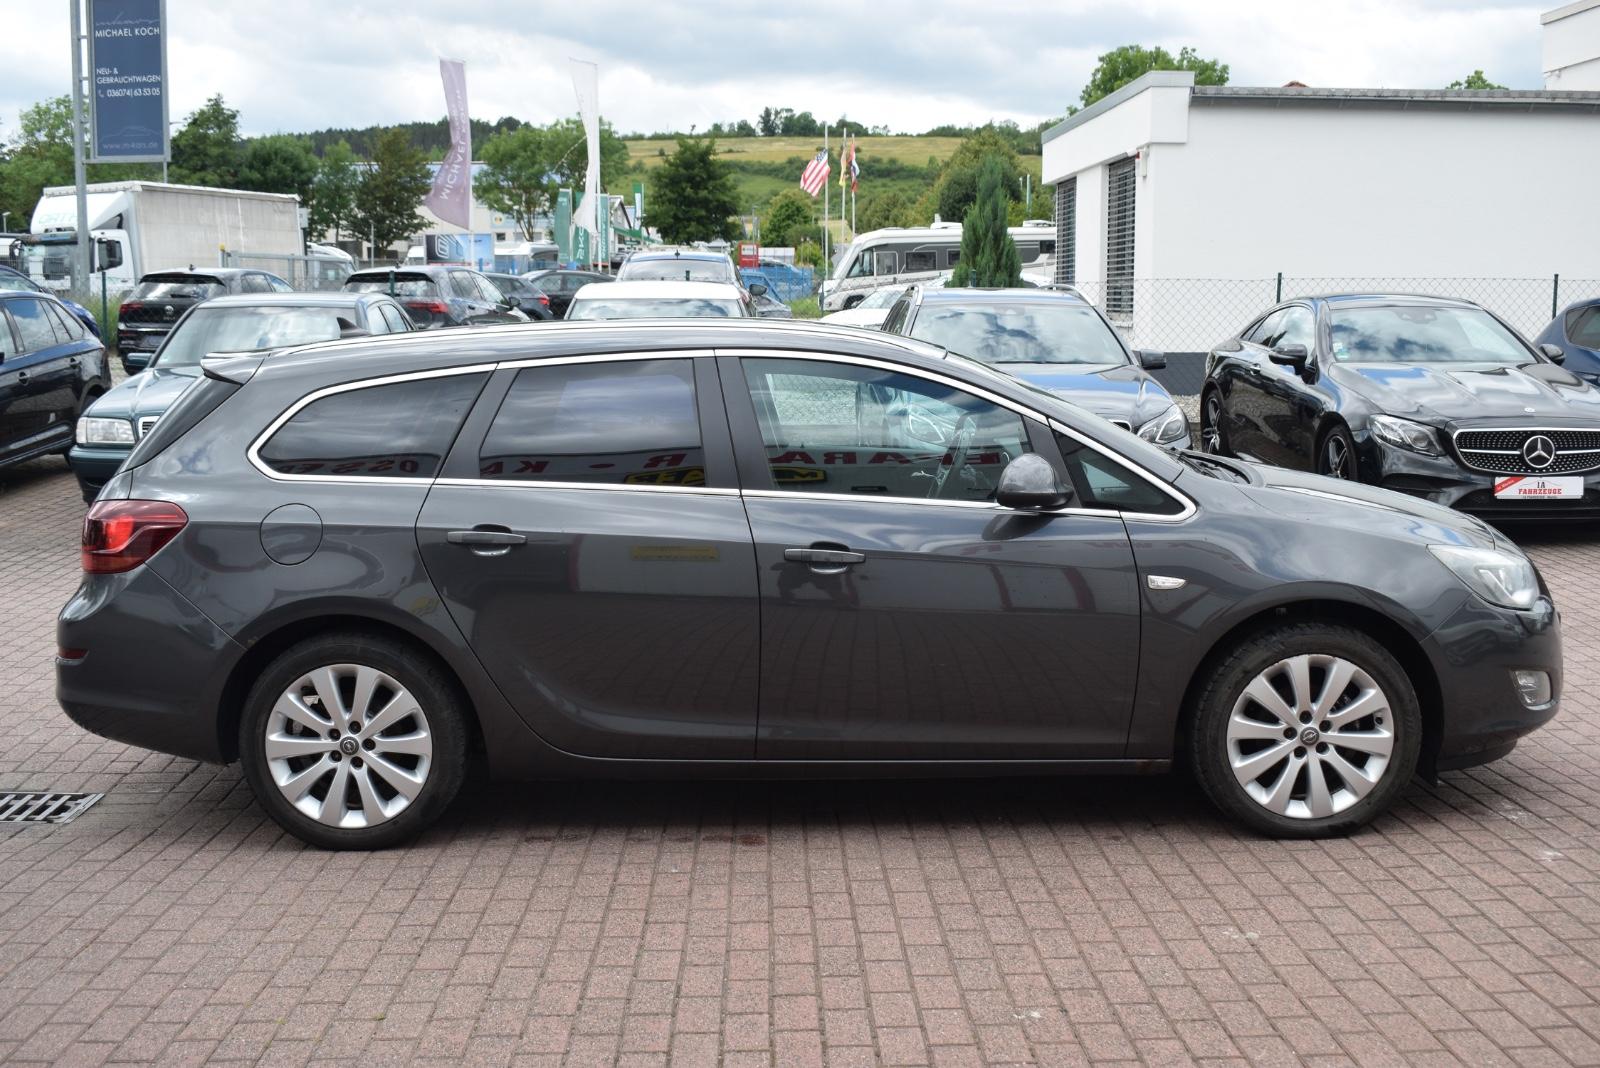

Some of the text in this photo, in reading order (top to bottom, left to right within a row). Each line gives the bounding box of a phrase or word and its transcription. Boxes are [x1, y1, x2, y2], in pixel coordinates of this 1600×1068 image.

[95, 27, 160, 38] MICHAEL KOCH
[96, 67, 112, 75] NEU-
[96, 75, 161, 84] GEBRAUCHTWAGEN
